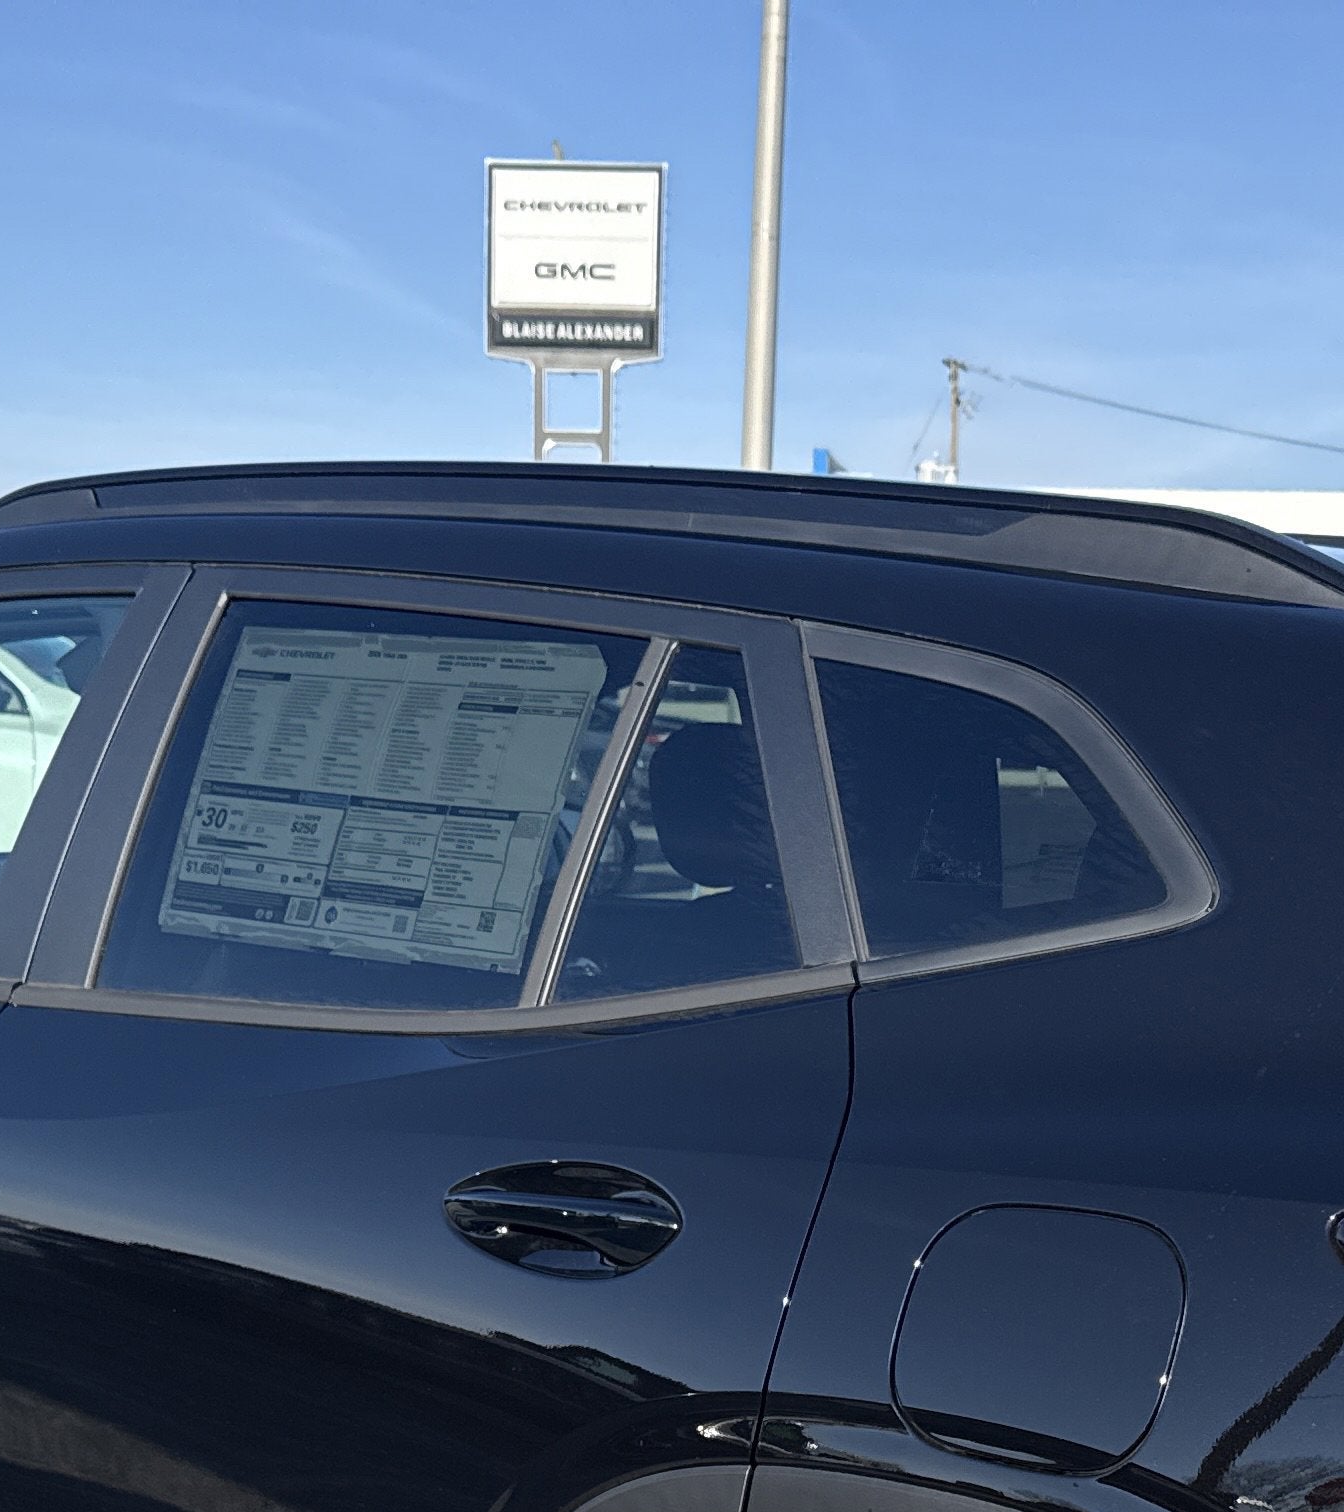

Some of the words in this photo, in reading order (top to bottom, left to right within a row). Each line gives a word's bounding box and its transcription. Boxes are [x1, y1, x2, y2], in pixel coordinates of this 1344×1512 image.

[503, 199, 648, 214] CHEVROLET
[534, 262, 616, 281] GMC
[502, 320, 554, 340] BLAISE
[556, 321, 644, 342] ALEXANDER
[201, 807, 229, 829] 30
